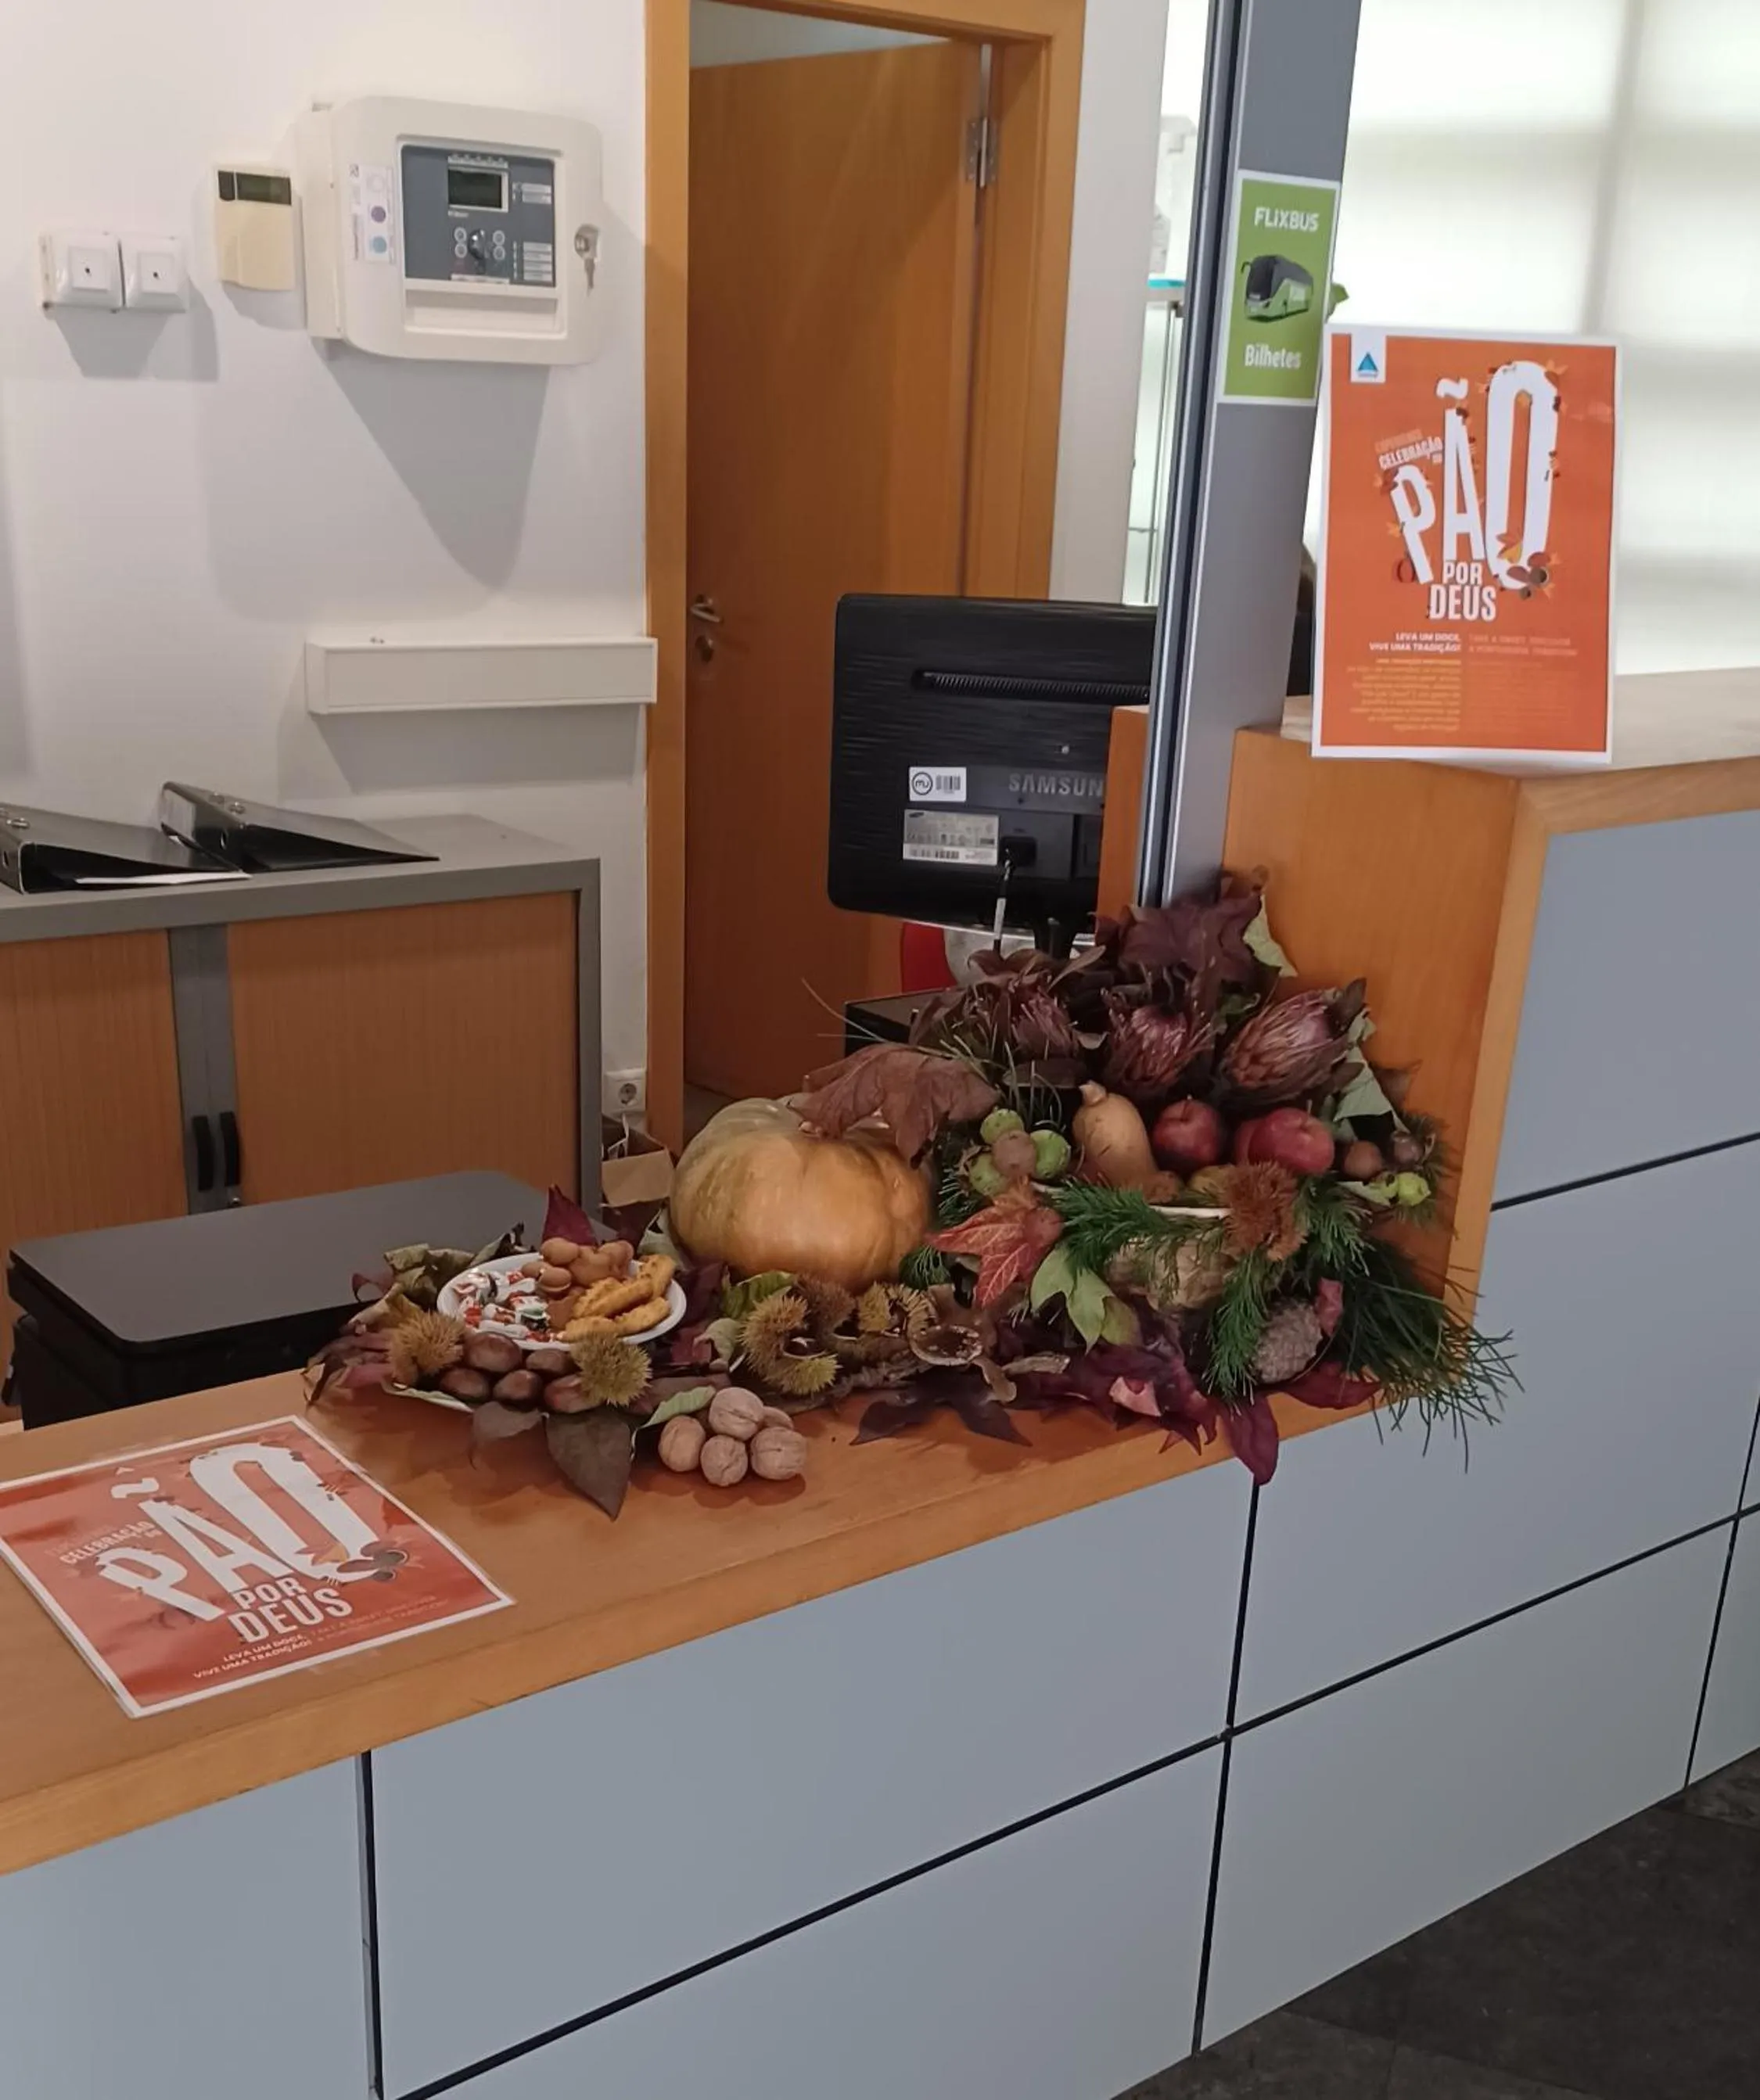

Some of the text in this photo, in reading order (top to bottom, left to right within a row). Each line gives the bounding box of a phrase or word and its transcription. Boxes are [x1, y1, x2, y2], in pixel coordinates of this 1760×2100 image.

[1254, 206, 1320, 232] FLIXBUS
[1245, 343, 1302, 369] Bilhetes
[1390, 361, 1558, 590] PÃO
[1442, 561, 1483, 585] POR
[1429, 583, 1496, 622] DEUS
[1008, 773, 1104, 797] SAMSUN
[95, 1443, 379, 1621] PÃO
[232, 1577, 306, 1610] POR
[228, 1587, 352, 1642] DEUS
[223, 1649, 252, 1662] LEVA
